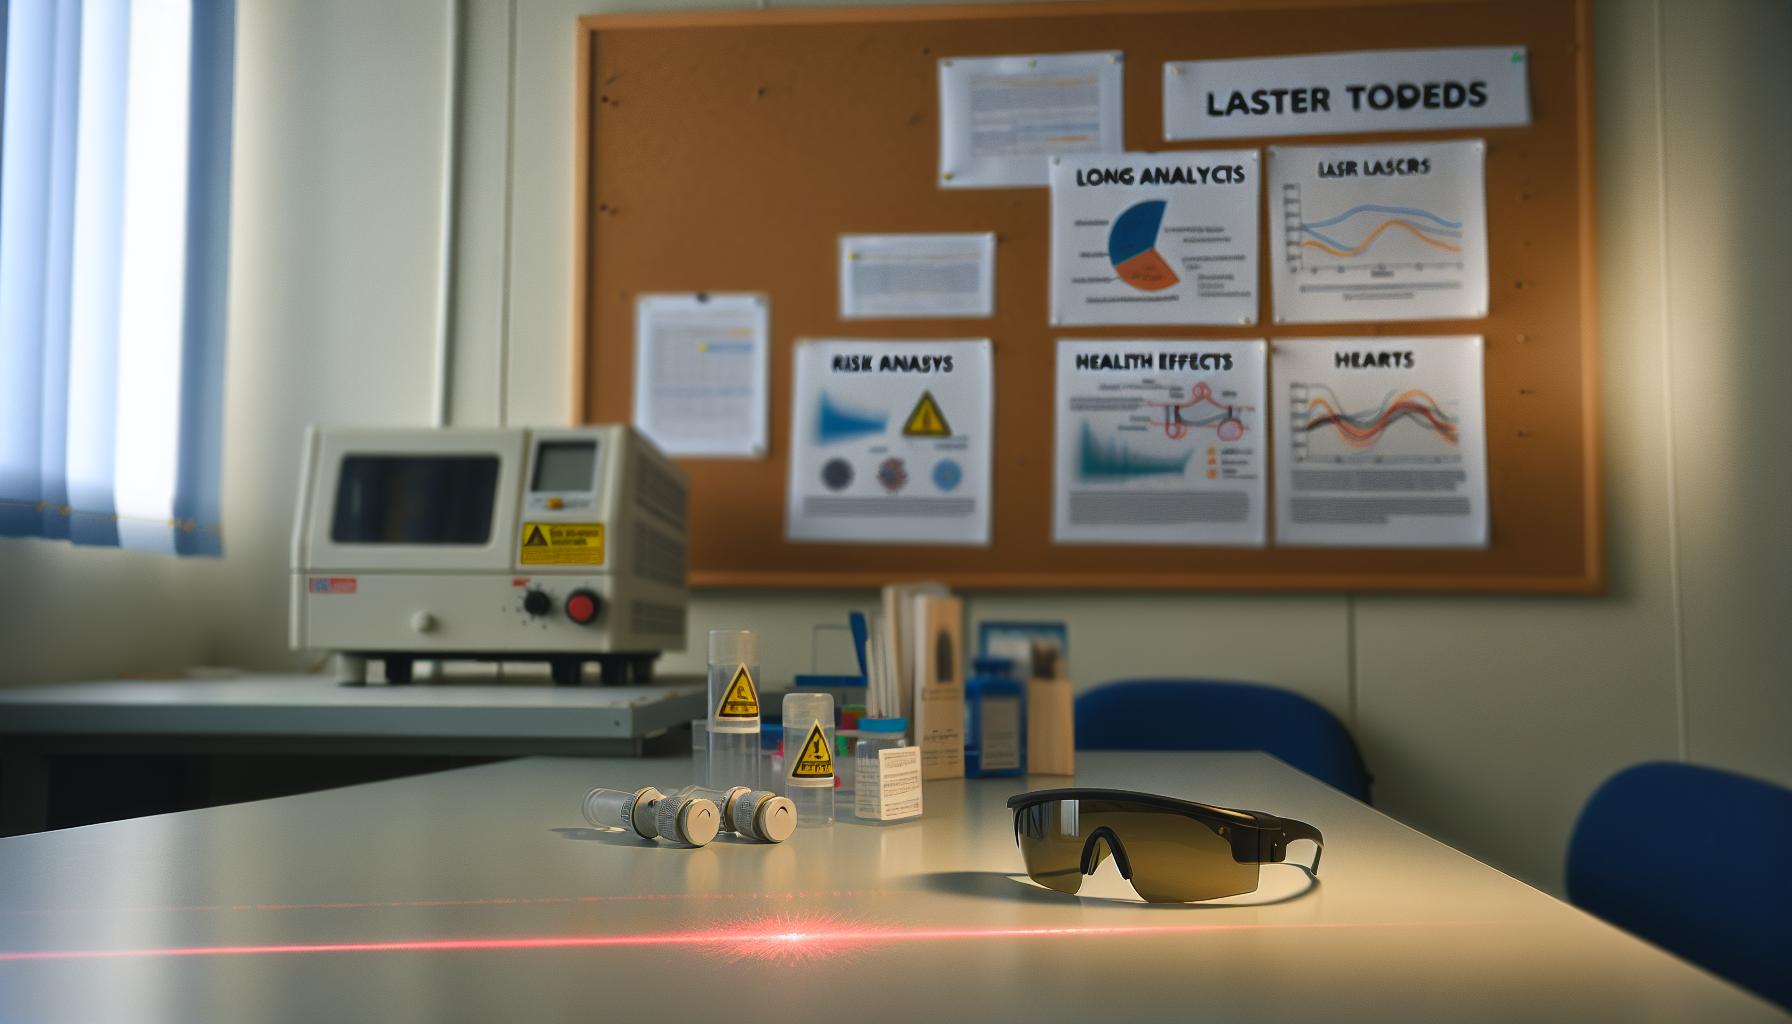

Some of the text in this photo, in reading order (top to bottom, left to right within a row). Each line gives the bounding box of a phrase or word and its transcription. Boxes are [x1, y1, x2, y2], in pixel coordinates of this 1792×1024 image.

[1207, 87, 1331, 117] LASTER
[1076, 167, 1135, 187] LONG
[832, 354, 873, 373] RISK
[1334, 350, 1415, 369] HEARTS
